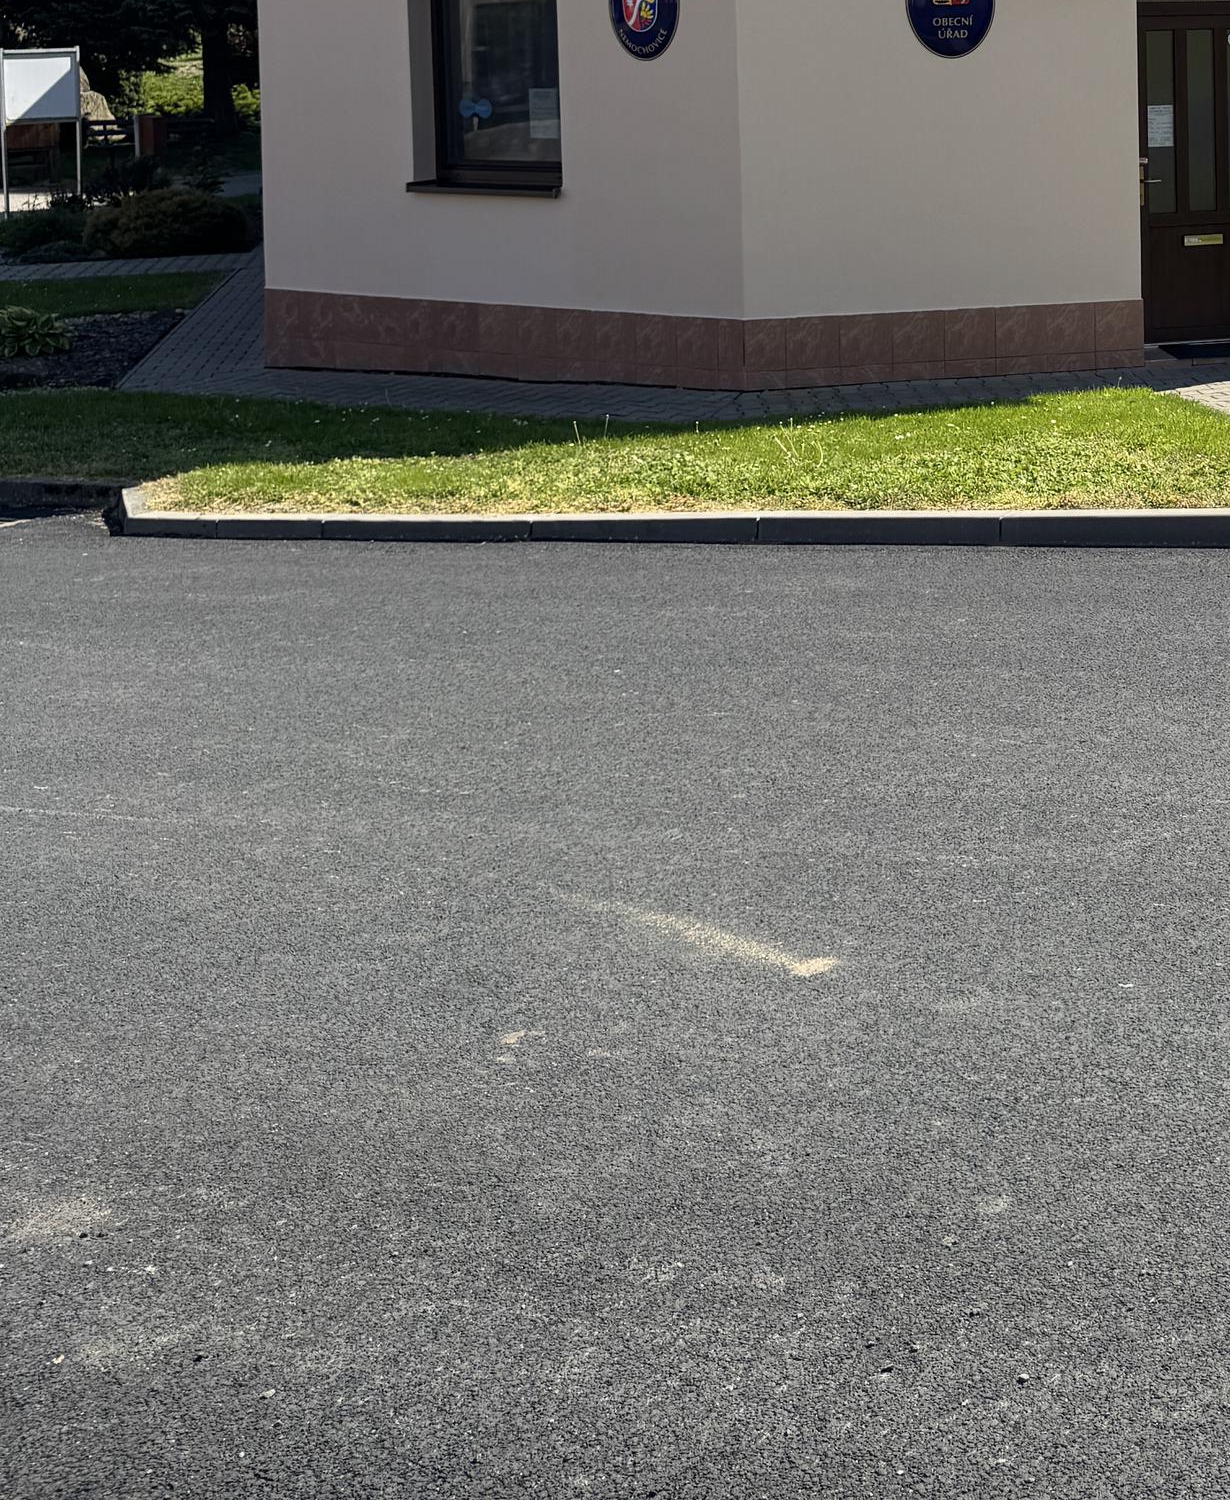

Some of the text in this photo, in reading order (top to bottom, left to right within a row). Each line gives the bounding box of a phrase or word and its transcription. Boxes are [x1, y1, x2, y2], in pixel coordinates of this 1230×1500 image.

[932, 14, 973, 27] OBECNÍ
[938, 27, 969, 39] ÚŘAD
[618, 27, 668, 55] NEMOCHOVICE
